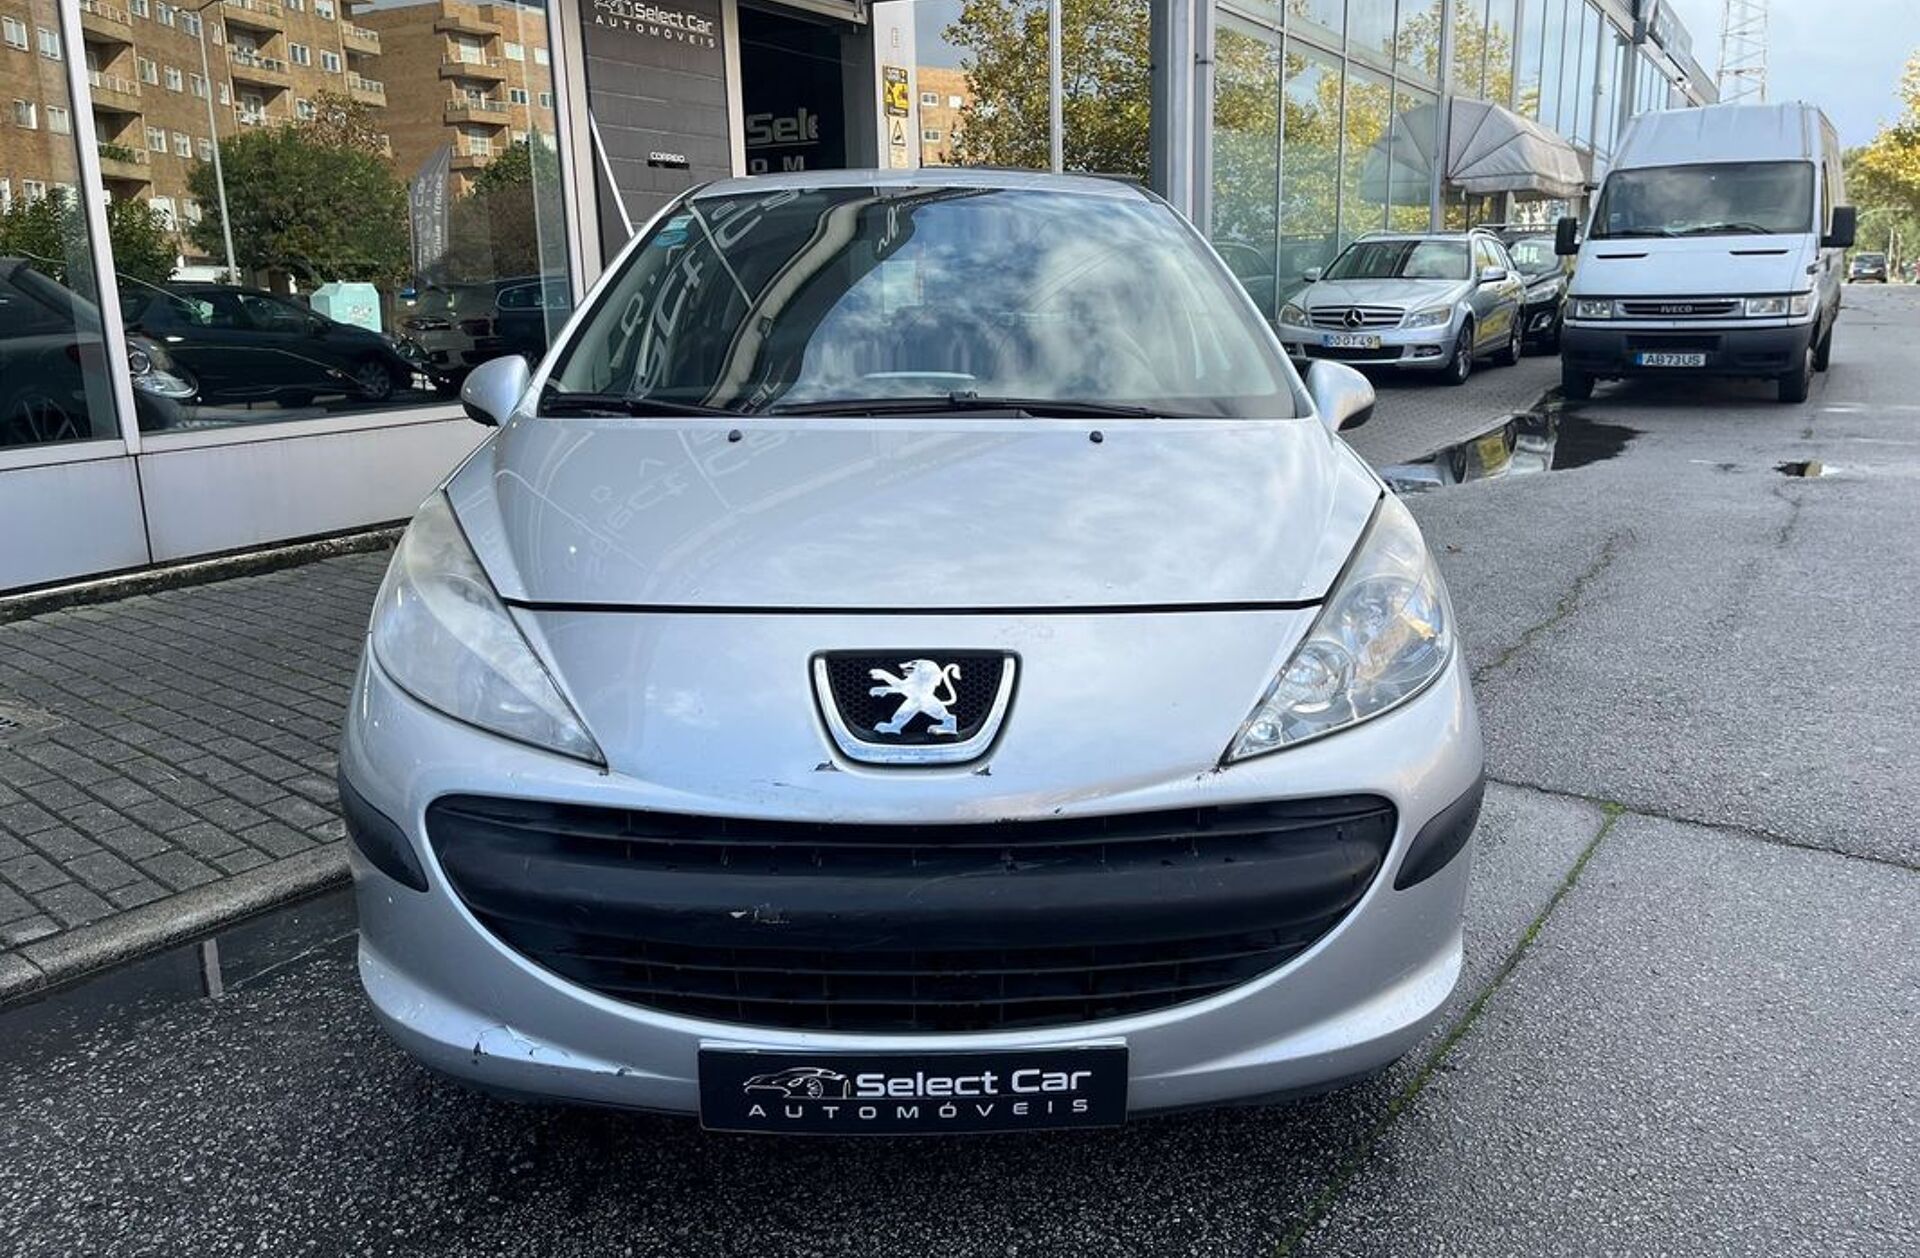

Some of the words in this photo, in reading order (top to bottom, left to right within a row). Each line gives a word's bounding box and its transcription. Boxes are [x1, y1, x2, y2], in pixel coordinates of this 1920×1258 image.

[635, 2, 683, 28] Select
[687, 14, 713, 33] Car
[1660, 305, 1692, 313] IVECO
[855, 1070, 999, 1097] Select
[1010, 1069, 1092, 1094] Car
[749, 1099, 1089, 1119] AUTOMÓVEIS
